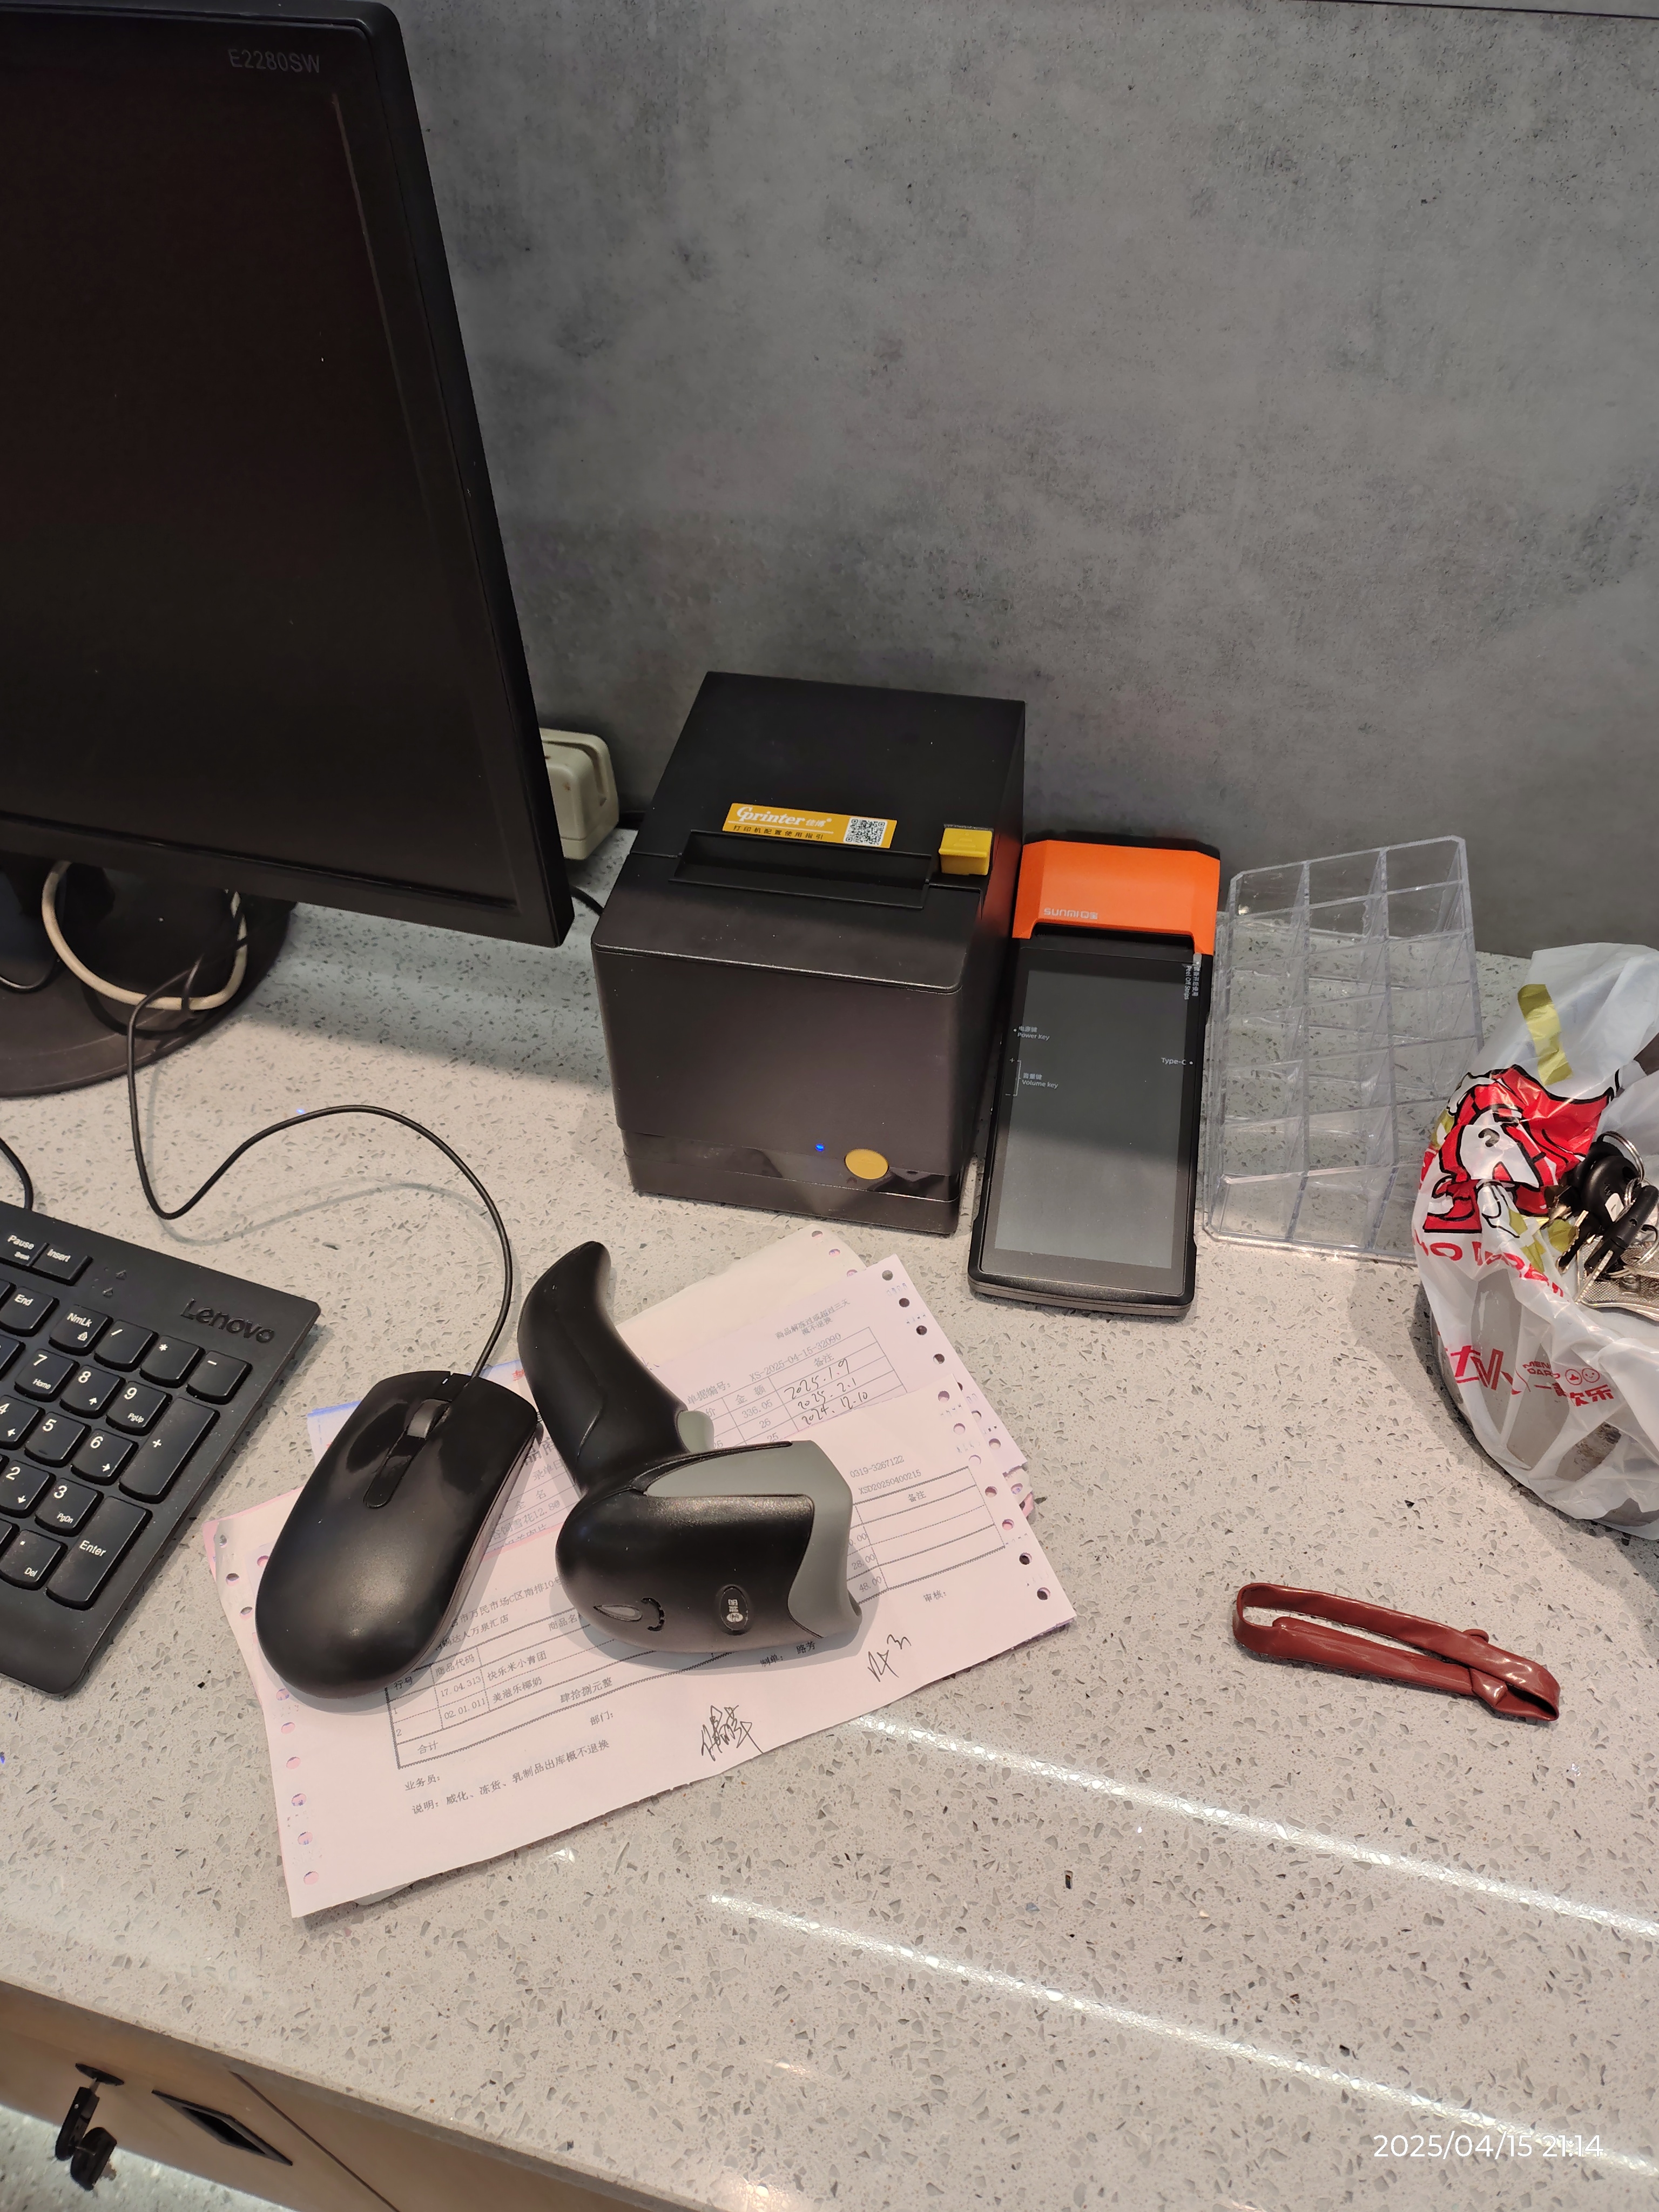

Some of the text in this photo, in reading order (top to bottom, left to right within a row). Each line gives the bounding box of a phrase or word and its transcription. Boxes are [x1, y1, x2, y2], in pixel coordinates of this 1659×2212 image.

[736, 806, 805, 826] Gprinter
[1161, 1057, 1188, 1066] Type-C
[1022, 1079, 1046, 1088] Volume
[7, 1235, 35, 1250] Pause
[46, 1249, 71, 1262] Insert
[14, 1294, 33, 1306] End
[66, 1312, 92, 1327] NmLk
[180, 1297, 275, 1343] Lenovo
[33, 1353, 48, 1366] 7
[748, 1332, 842, 1382] XS-2025-04-15-32090
[813, 1353, 835, 1368] 备注
[33, 1378, 51, 1390] Home
[78, 1370, 91, 1384] 8
[123, 1387, 138, 1400] 9
[741, 1398, 774, 1419] 336.05
[42, 1418, 57, 1433] 5
[127, 1412, 144, 1424] PgUp
[759, 1418, 772, 1429] 26
[90, 1435, 104, 1449] 6
[766, 1432, 779, 1443] 25
[5, 1466, 21, 1481] 2
[849, 1454, 905, 1479] 0319-3267122
[858, 1469, 922, 1495] XSD20250400215
[53, 1485, 68, 1499] 3
[907, 1490, 927, 1503] 备注
[57, 1512, 73, 1524] PgDn
[79, 1540, 106, 1557] Enter
[852, 1554, 876, 1571] 28.00
[24, 1567, 38, 1578] Del
[859, 1575, 882, 1593] 48.00
[435, 1654, 476, 1677] 商品代码
[487, 1650, 548, 1682] 快乐米小青团
[394, 1676, 414, 1691] 行号
[395, 1728, 402, 1737] 2
[417, 1740, 439, 1755] 合计
